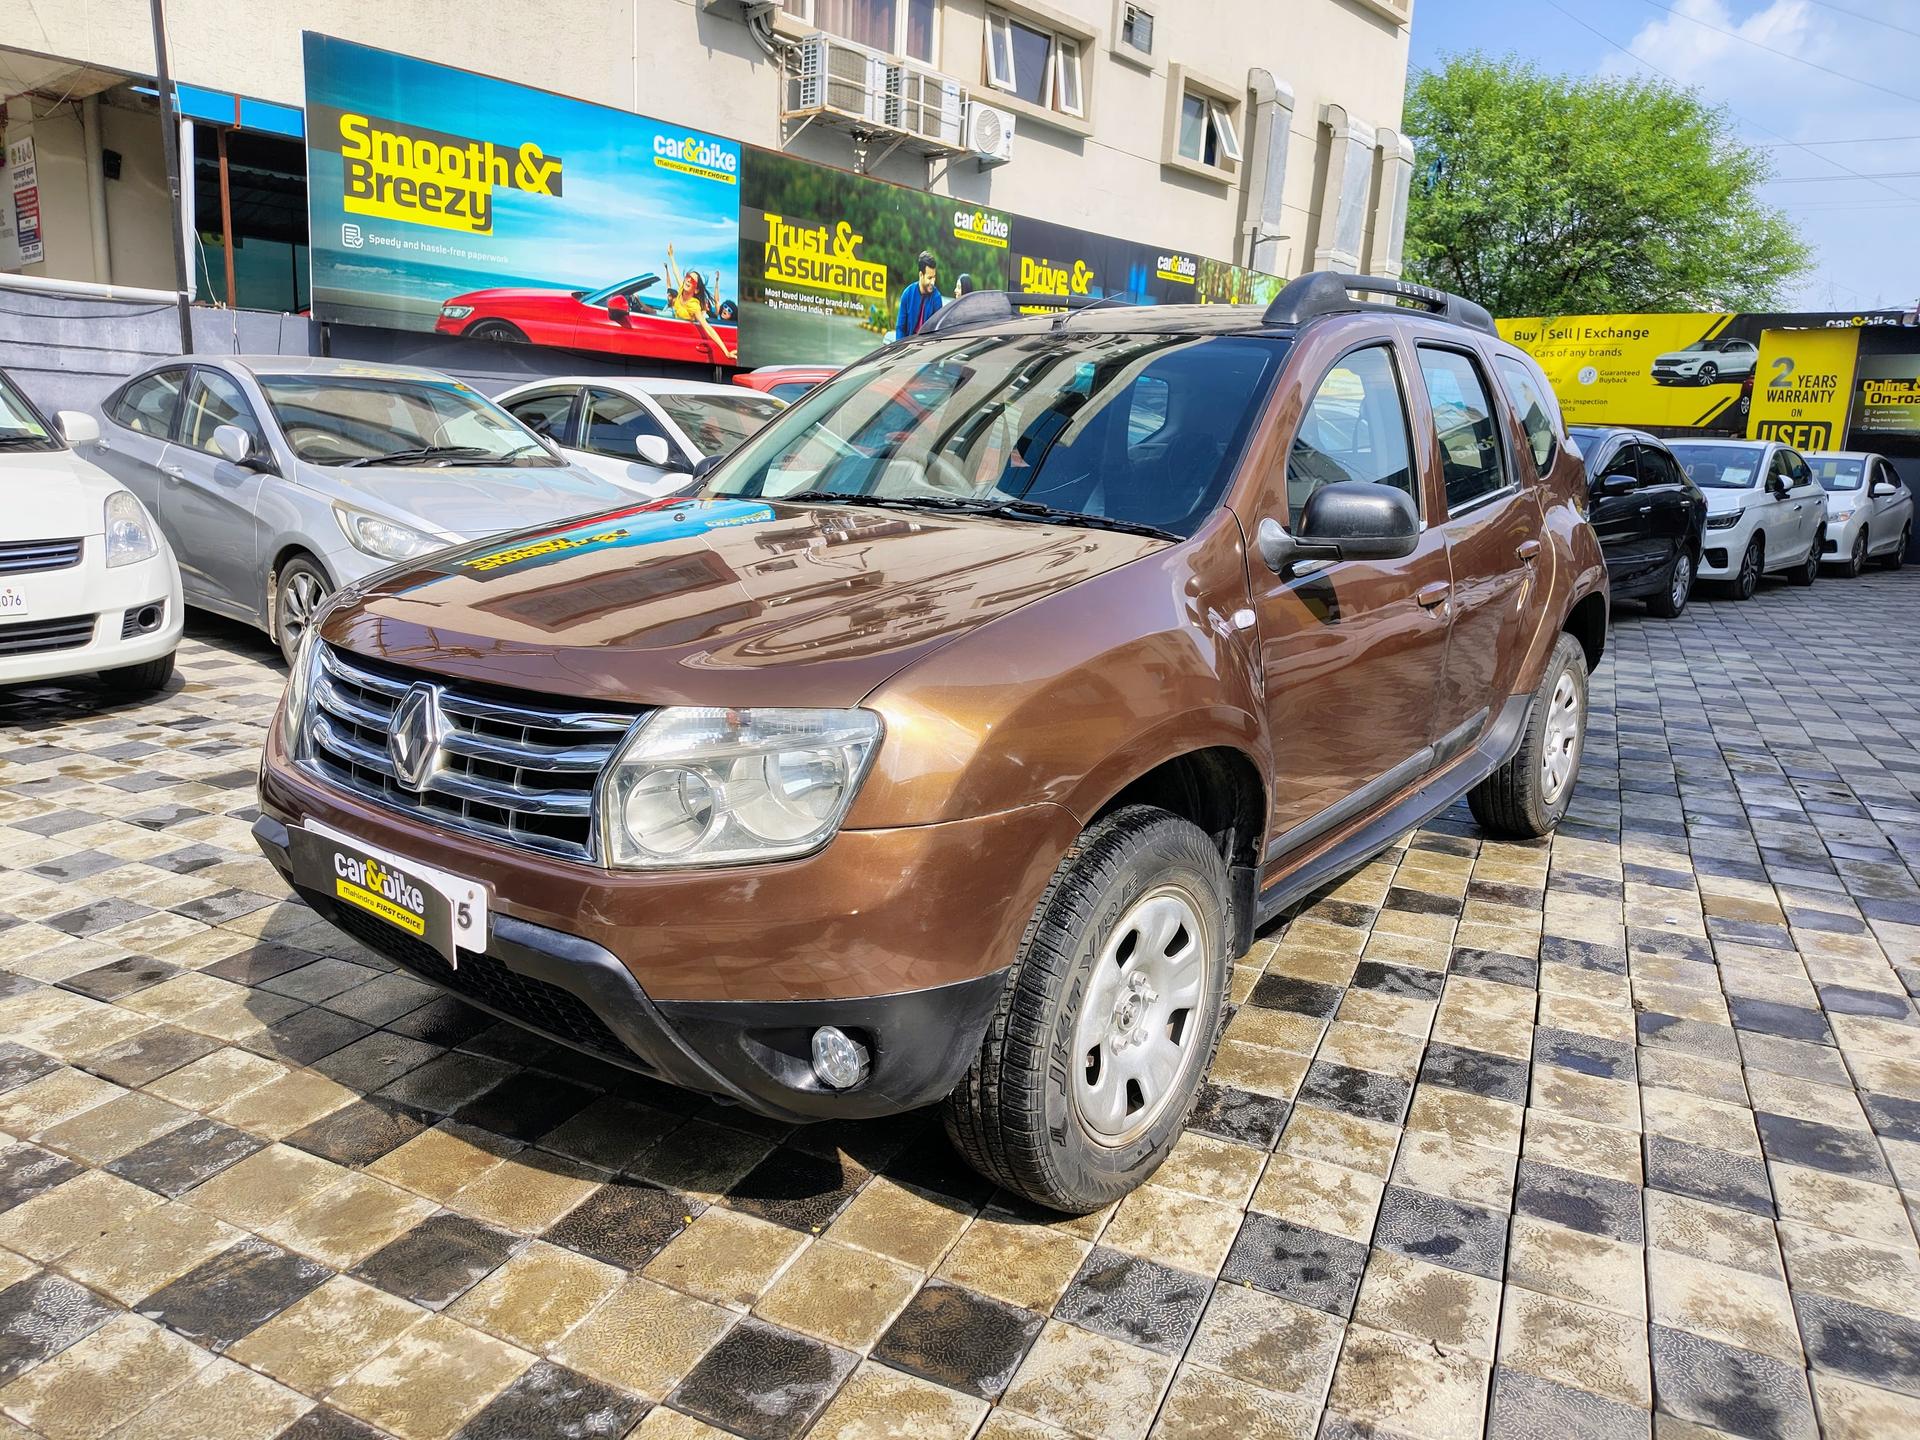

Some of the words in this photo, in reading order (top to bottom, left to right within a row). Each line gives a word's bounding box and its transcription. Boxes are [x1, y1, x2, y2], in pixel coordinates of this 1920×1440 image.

[339, 113, 509, 187] Smooth
[514, 142, 563, 196] &
[653, 134, 736, 172] car&bike
[688, 167, 707, 176] FIRST
[707, 171, 730, 181] CHOICE
[344, 158, 492, 231] Breezy
[764, 212, 828, 255] Trust
[833, 221, 863, 261] &
[953, 211, 1009, 238] car&bike
[368, 233, 401, 249] Speedy
[402, 240, 419, 250] and
[420, 241, 466, 258] hassle-free
[467, 250, 509, 264] paperwork
[764, 244, 884, 292] Assurance
[1021, 256, 1069, 288] Drive
[1071, 259, 1094, 294] &
[1157, 255, 1196, 276] car&bike
[765, 287, 781, 298] Most
[781, 290, 798, 301] loved
[799, 293, 814, 303] Used
[814, 296, 825, 304] Car
[825, 297, 842, 308] brand
[842, 300, 849, 308] of
[850, 302, 864, 311] India
[1396, 281, 1441, 302] DUSTER
[768, 299, 778, 310] By
[778, 301, 808, 313] Franchise
[808, 305, 825, 316] India,
[825, 308, 833, 316] ET
[1514, 330, 1537, 342] Buy
[1548, 328, 1573, 340] Sell
[1584, 327, 1649, 342] Exchange
[1534, 349, 1555, 358] Cars
[1556, 348, 1567, 357] of
[1569, 349, 1587, 359] any
[1589, 348, 1622, 357] brands
[1600, 369, 1640, 377] Guaranteed
[1768, 356, 1795, 388] 2
[1797, 375, 1838, 388] YEARS
[1767, 389, 1835, 404] WARRANTY
[1863, 379, 1910, 392] Online
[1573, 398, 1608, 407] inspection
[1791, 408, 1803, 417] ON
[1760, 424, 1827, 451] USED
[0, 593, 22, 607] 076
[334, 852, 425, 914] car&bike
[376, 902, 396, 916] FIRST
[396, 912, 422, 930] CHOICE
[456, 902, 472, 929] 5
